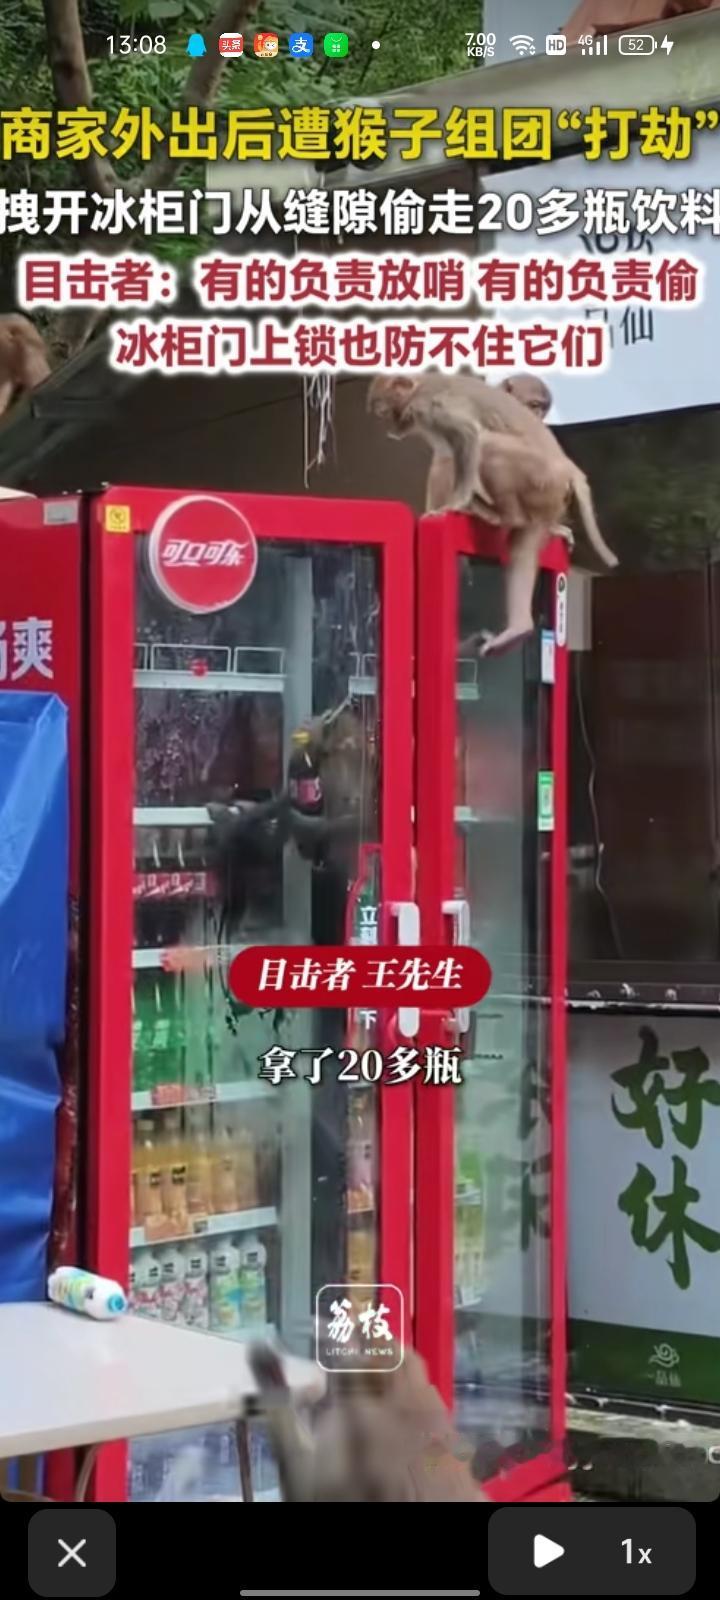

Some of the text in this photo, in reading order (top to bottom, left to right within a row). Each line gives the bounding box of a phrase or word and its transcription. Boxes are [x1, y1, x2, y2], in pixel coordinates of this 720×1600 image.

[162, 538, 249, 567] 可口可乐
[0, 616, 54, 680] 爽
